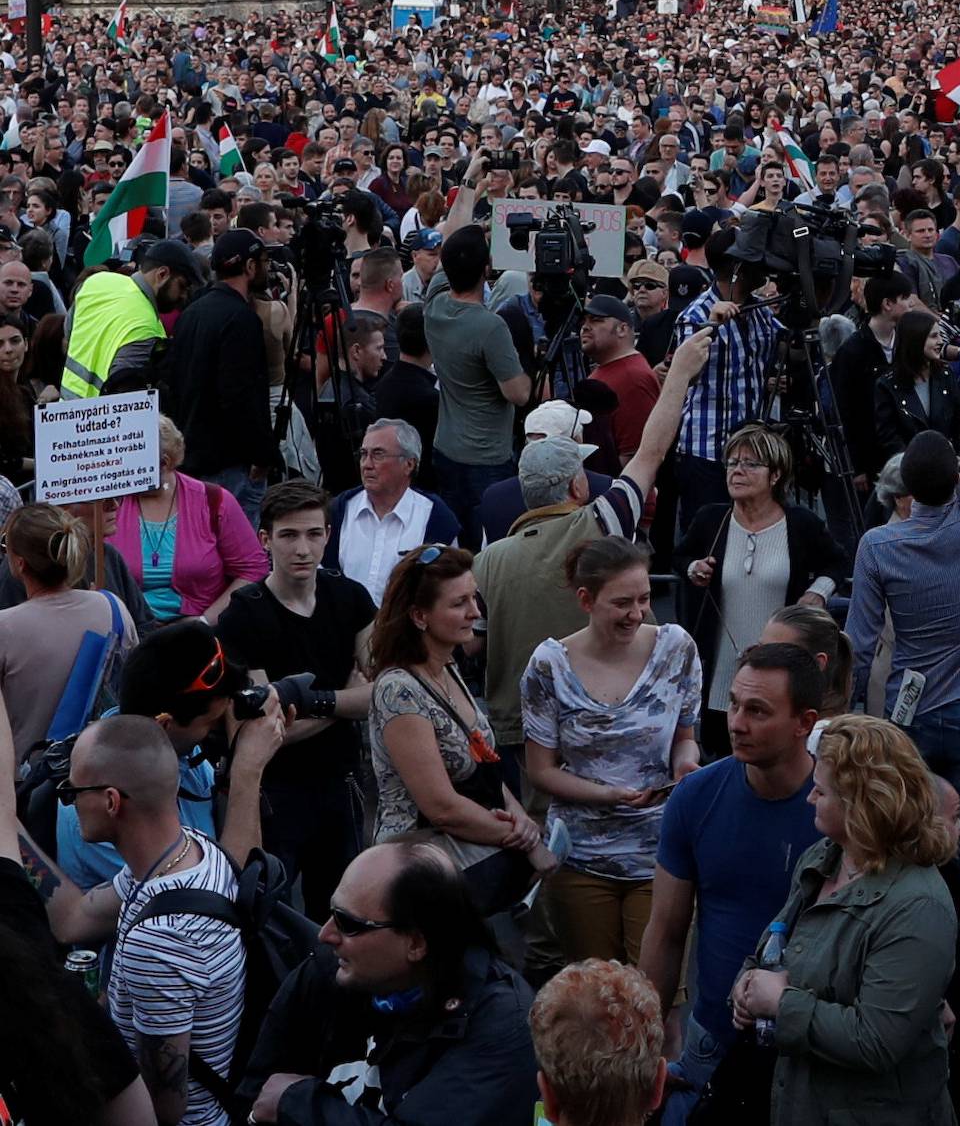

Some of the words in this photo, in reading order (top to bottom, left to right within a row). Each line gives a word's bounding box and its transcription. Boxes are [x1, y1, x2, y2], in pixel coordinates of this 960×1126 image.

[41, 404, 109, 423] Kormánypárti
[75, 416, 121, 433] tudtad-e?
[52, 434, 120, 451] Felhatalmazást
[122, 430, 144, 441] adtál
[50, 448, 104, 463] Orbánéknak
[115, 441, 146, 454] további
[76, 457, 123, 472] lopásokra!
[41, 480, 48, 488] A
[51, 475, 98, 488] migránsos
[137, 466, 147, 475] és
[45, 488, 93, 500] Soros-terv
[95, 480, 131, 493] csalétek
